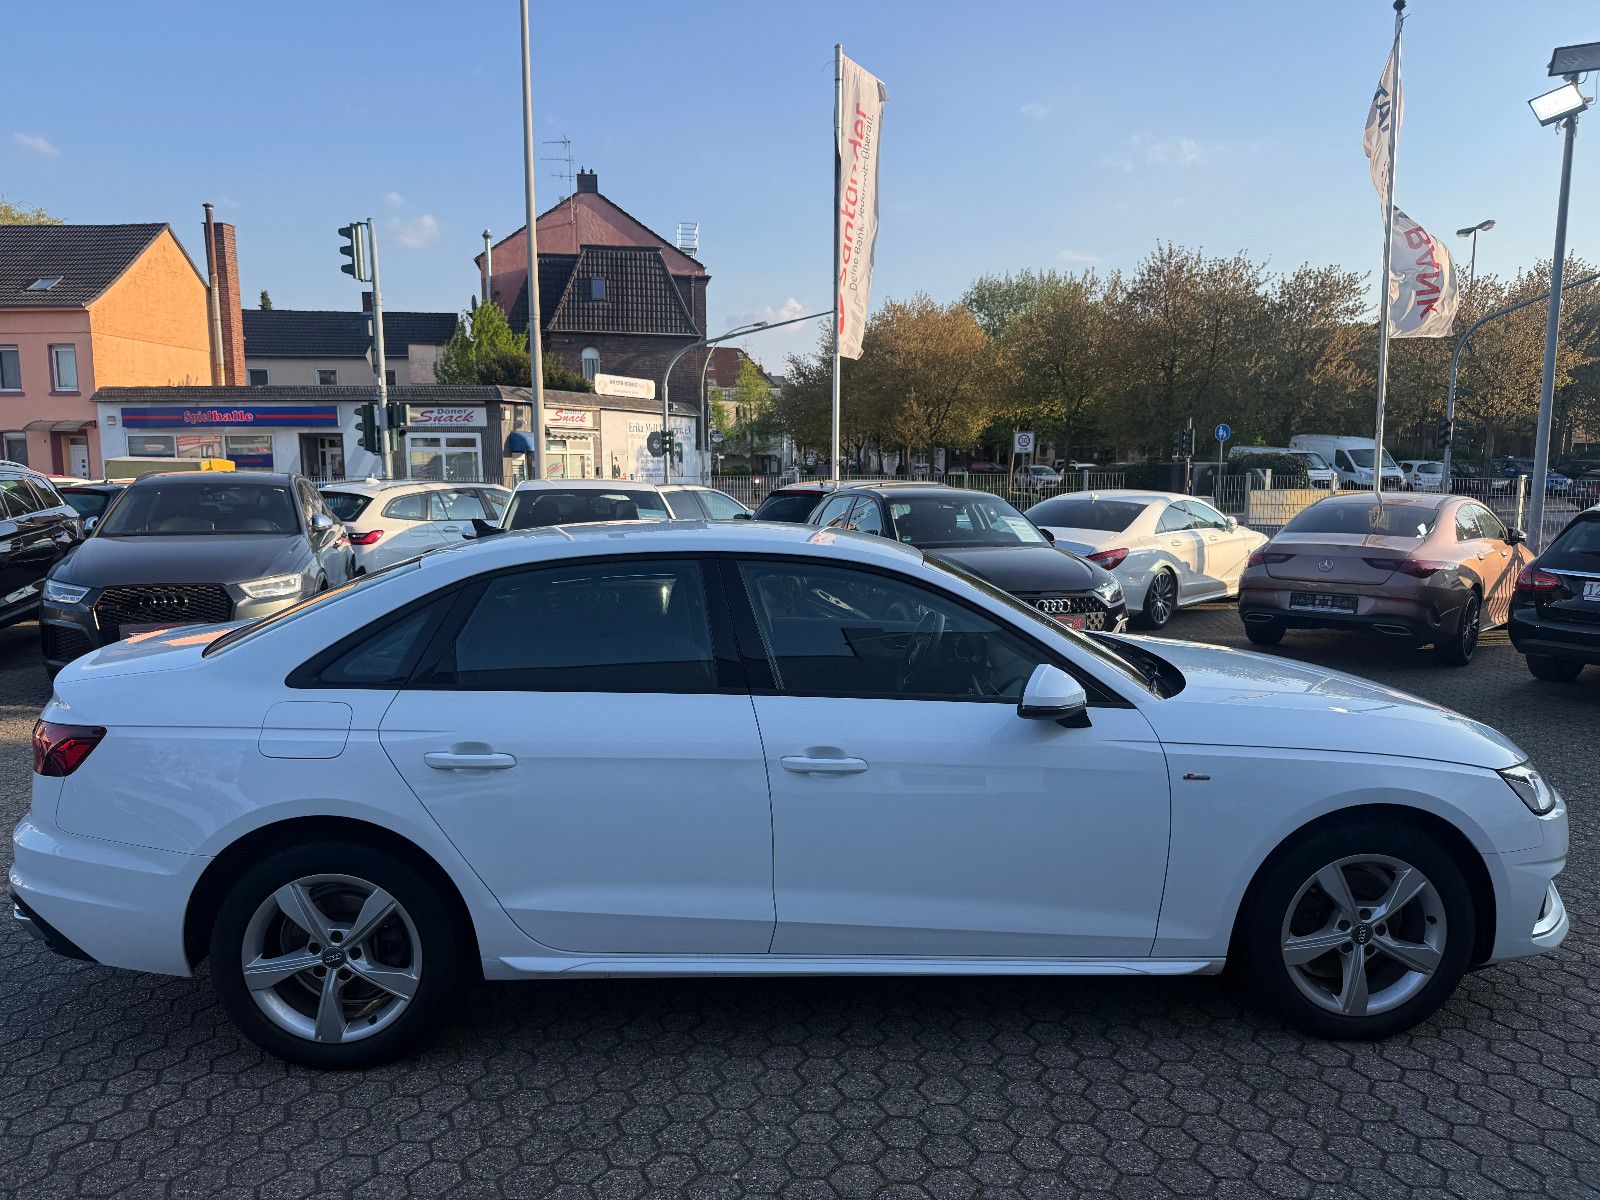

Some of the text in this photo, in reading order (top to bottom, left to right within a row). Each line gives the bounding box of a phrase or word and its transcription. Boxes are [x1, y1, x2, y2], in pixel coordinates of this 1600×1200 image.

[861, 114, 874, 160] Überall.
[853, 223, 865, 255] Bank.
[849, 257, 859, 291] Deine
[184, 410, 254, 424] Spielhalle
[415, 410, 474, 423] Snack
[549, 409, 586, 423] Snack
